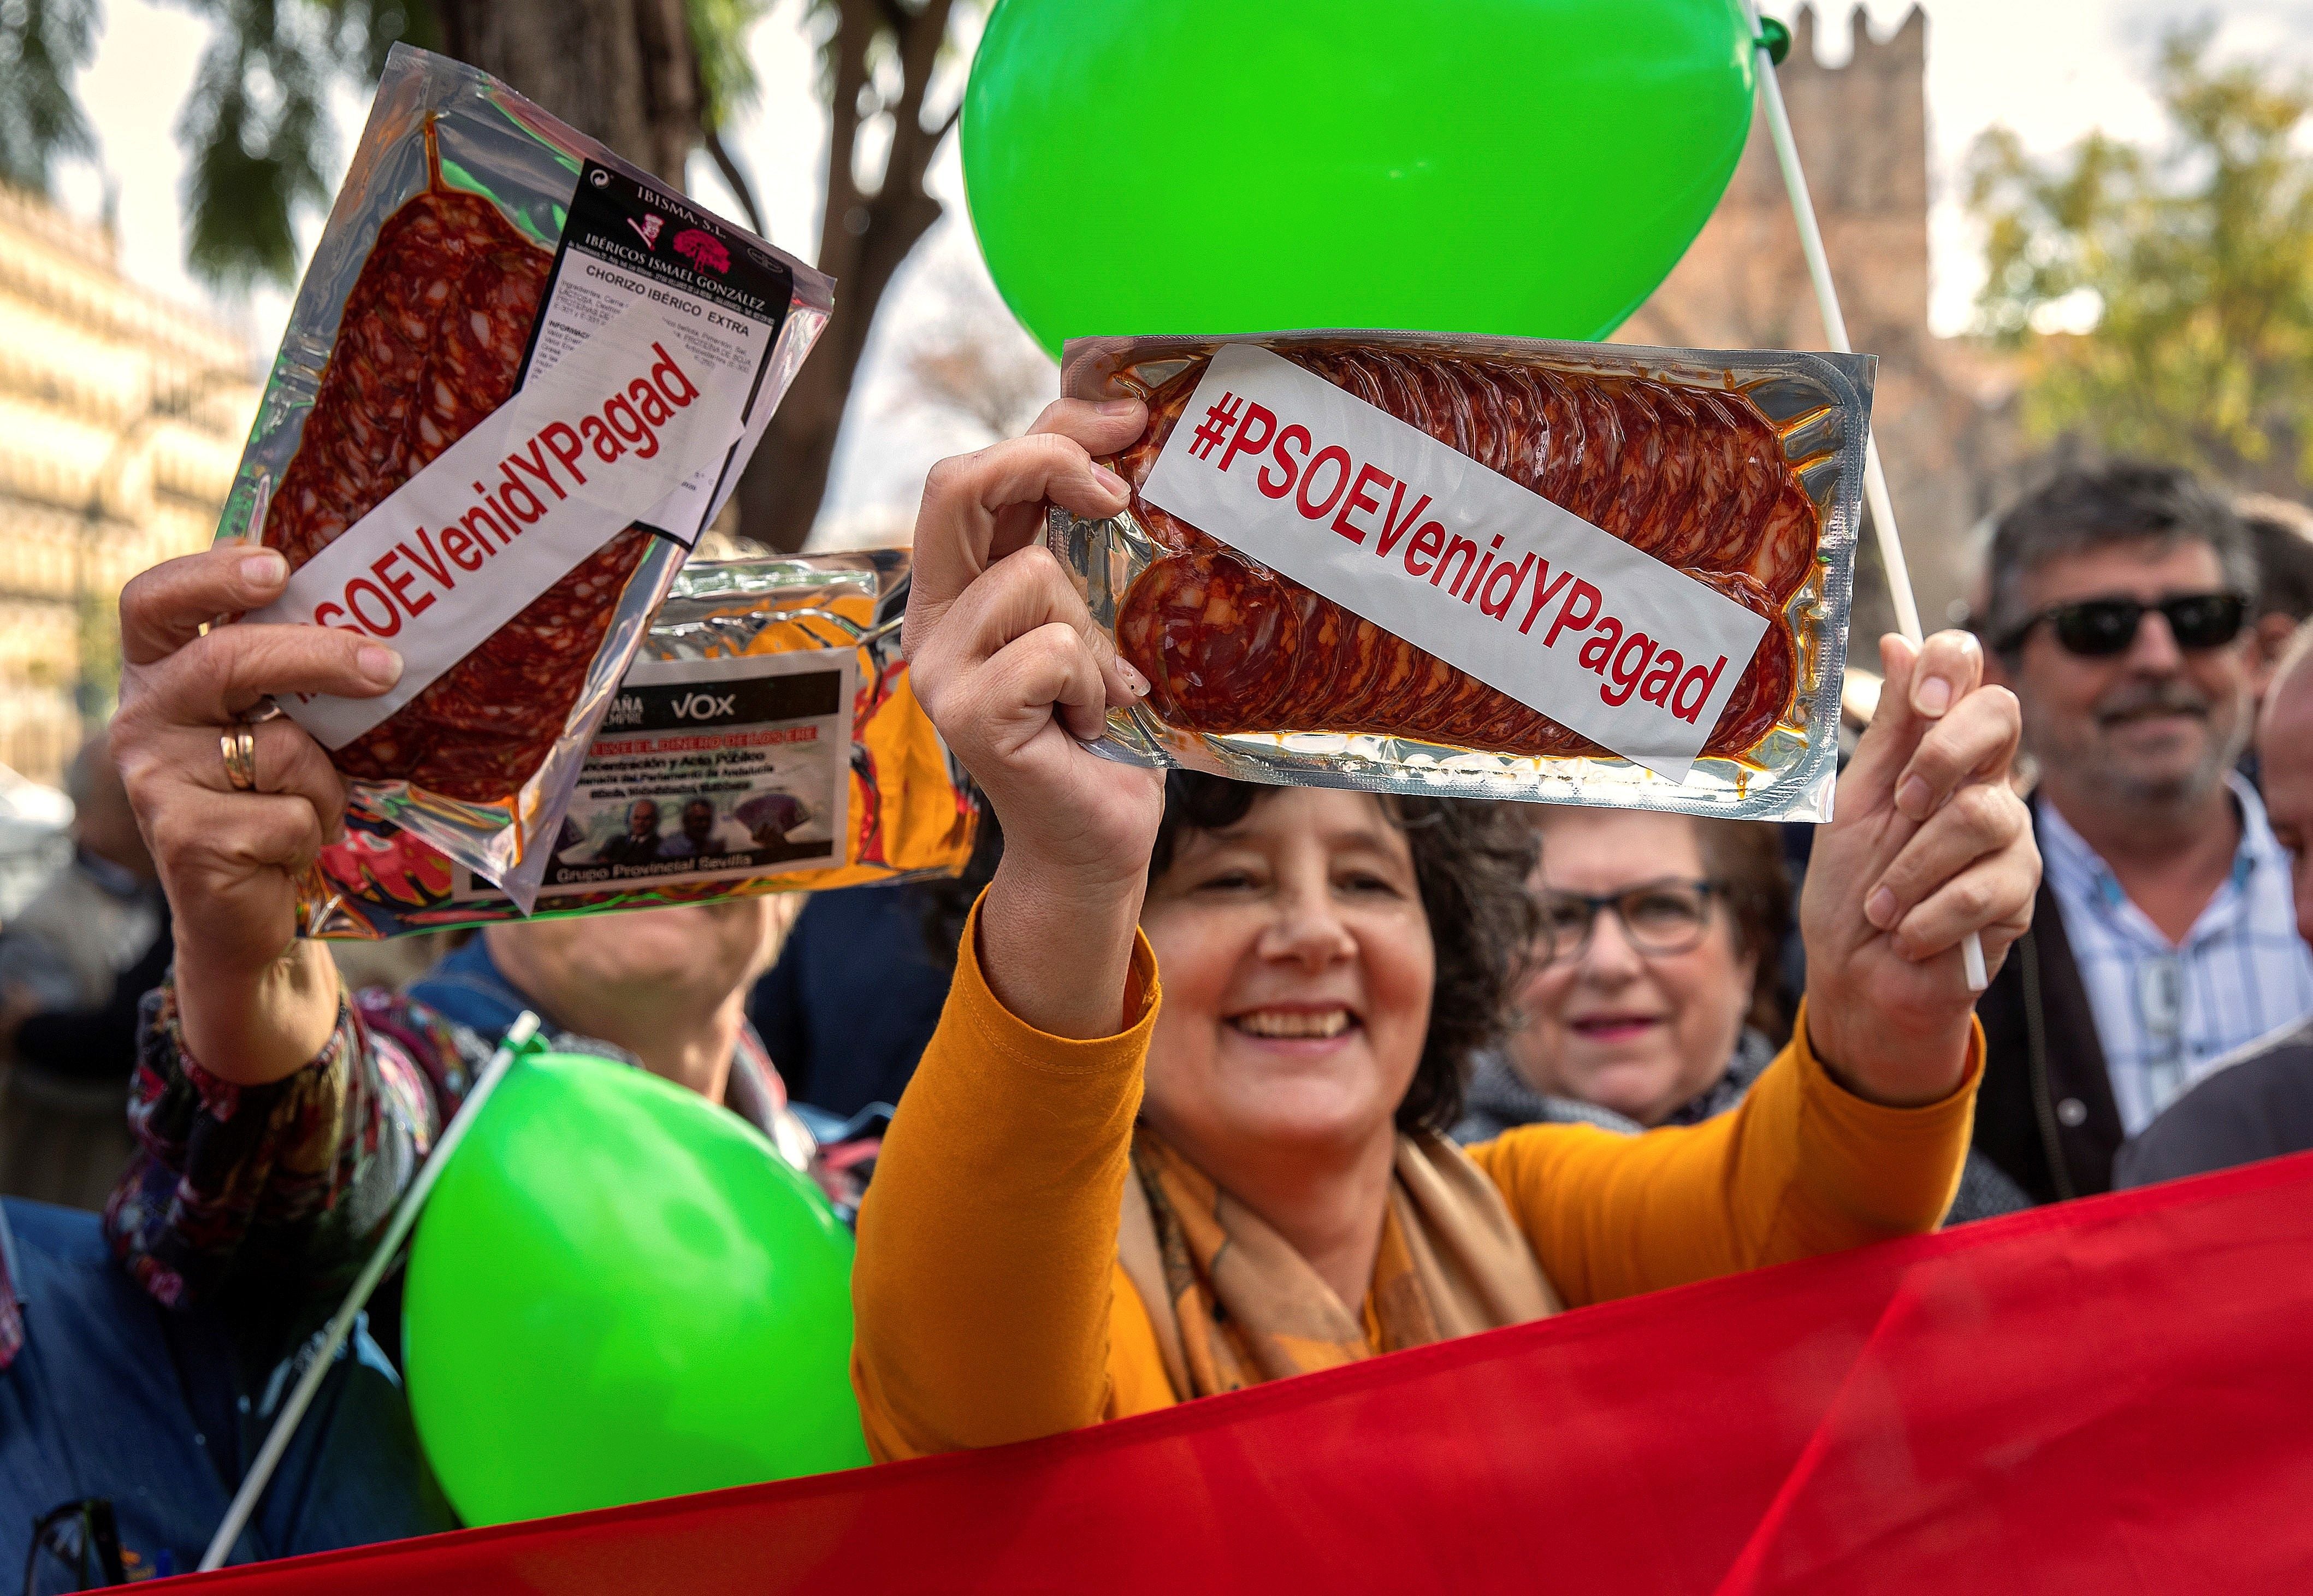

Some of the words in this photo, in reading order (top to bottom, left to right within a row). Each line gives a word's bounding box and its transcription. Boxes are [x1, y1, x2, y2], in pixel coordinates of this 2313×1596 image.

[585, 232, 647, 264] IBÉRICOS
[648, 256, 694, 283] ISMAEL
[696, 275, 766, 311] GONZÁLEZ
[586, 264, 646, 297] CHORIZO
[647, 286, 702, 317] IBÉRICO
[708, 311, 749, 336] EXTRA
[294, 341, 701, 705] SOEVenidYPagad
[1188, 391, 1728, 725] #PSOEVenidYPagad
[671, 692, 736, 720] VOX
[557, 867, 610, 884] Grupo
[613, 857, 695, 879] Provincial
[699, 854, 753, 870] Sevilla
